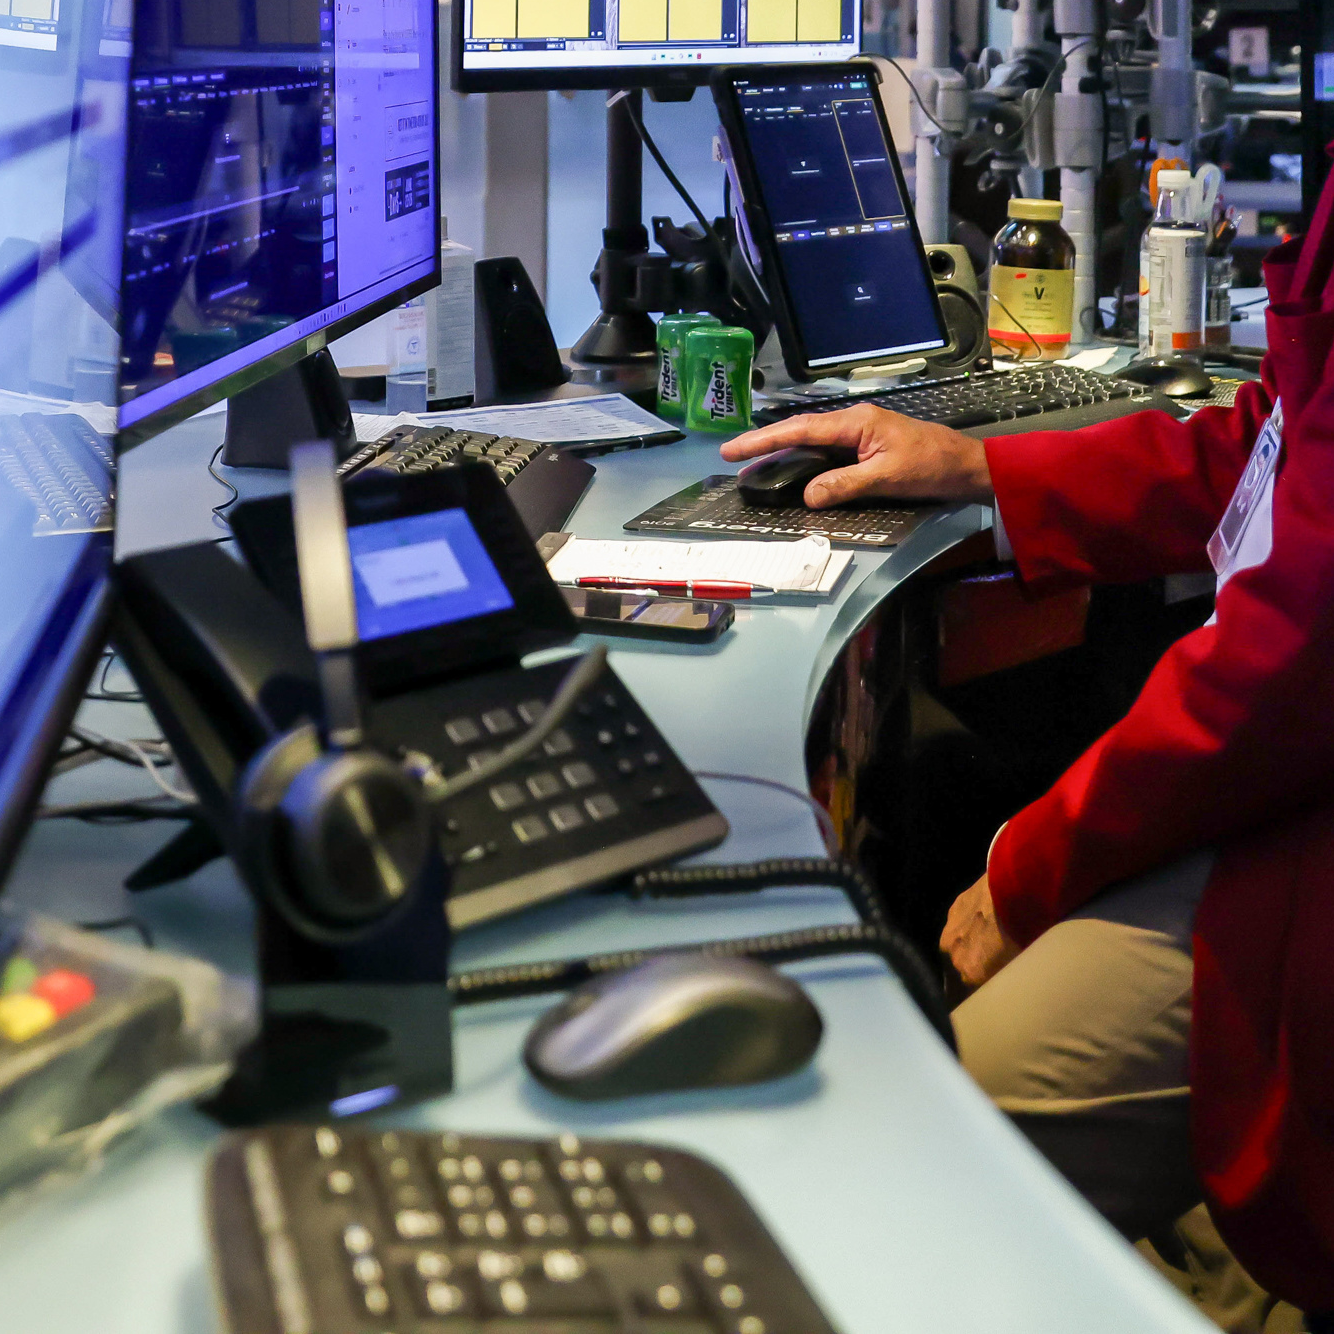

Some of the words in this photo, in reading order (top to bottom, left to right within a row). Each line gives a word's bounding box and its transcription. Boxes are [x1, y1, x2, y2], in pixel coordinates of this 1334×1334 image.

[660, 346, 670, 402] Trident
[710, 361, 725, 420] Trident
[725, 383, 735, 413] VIBES
[689, 521, 889, 542] Bloomberg
